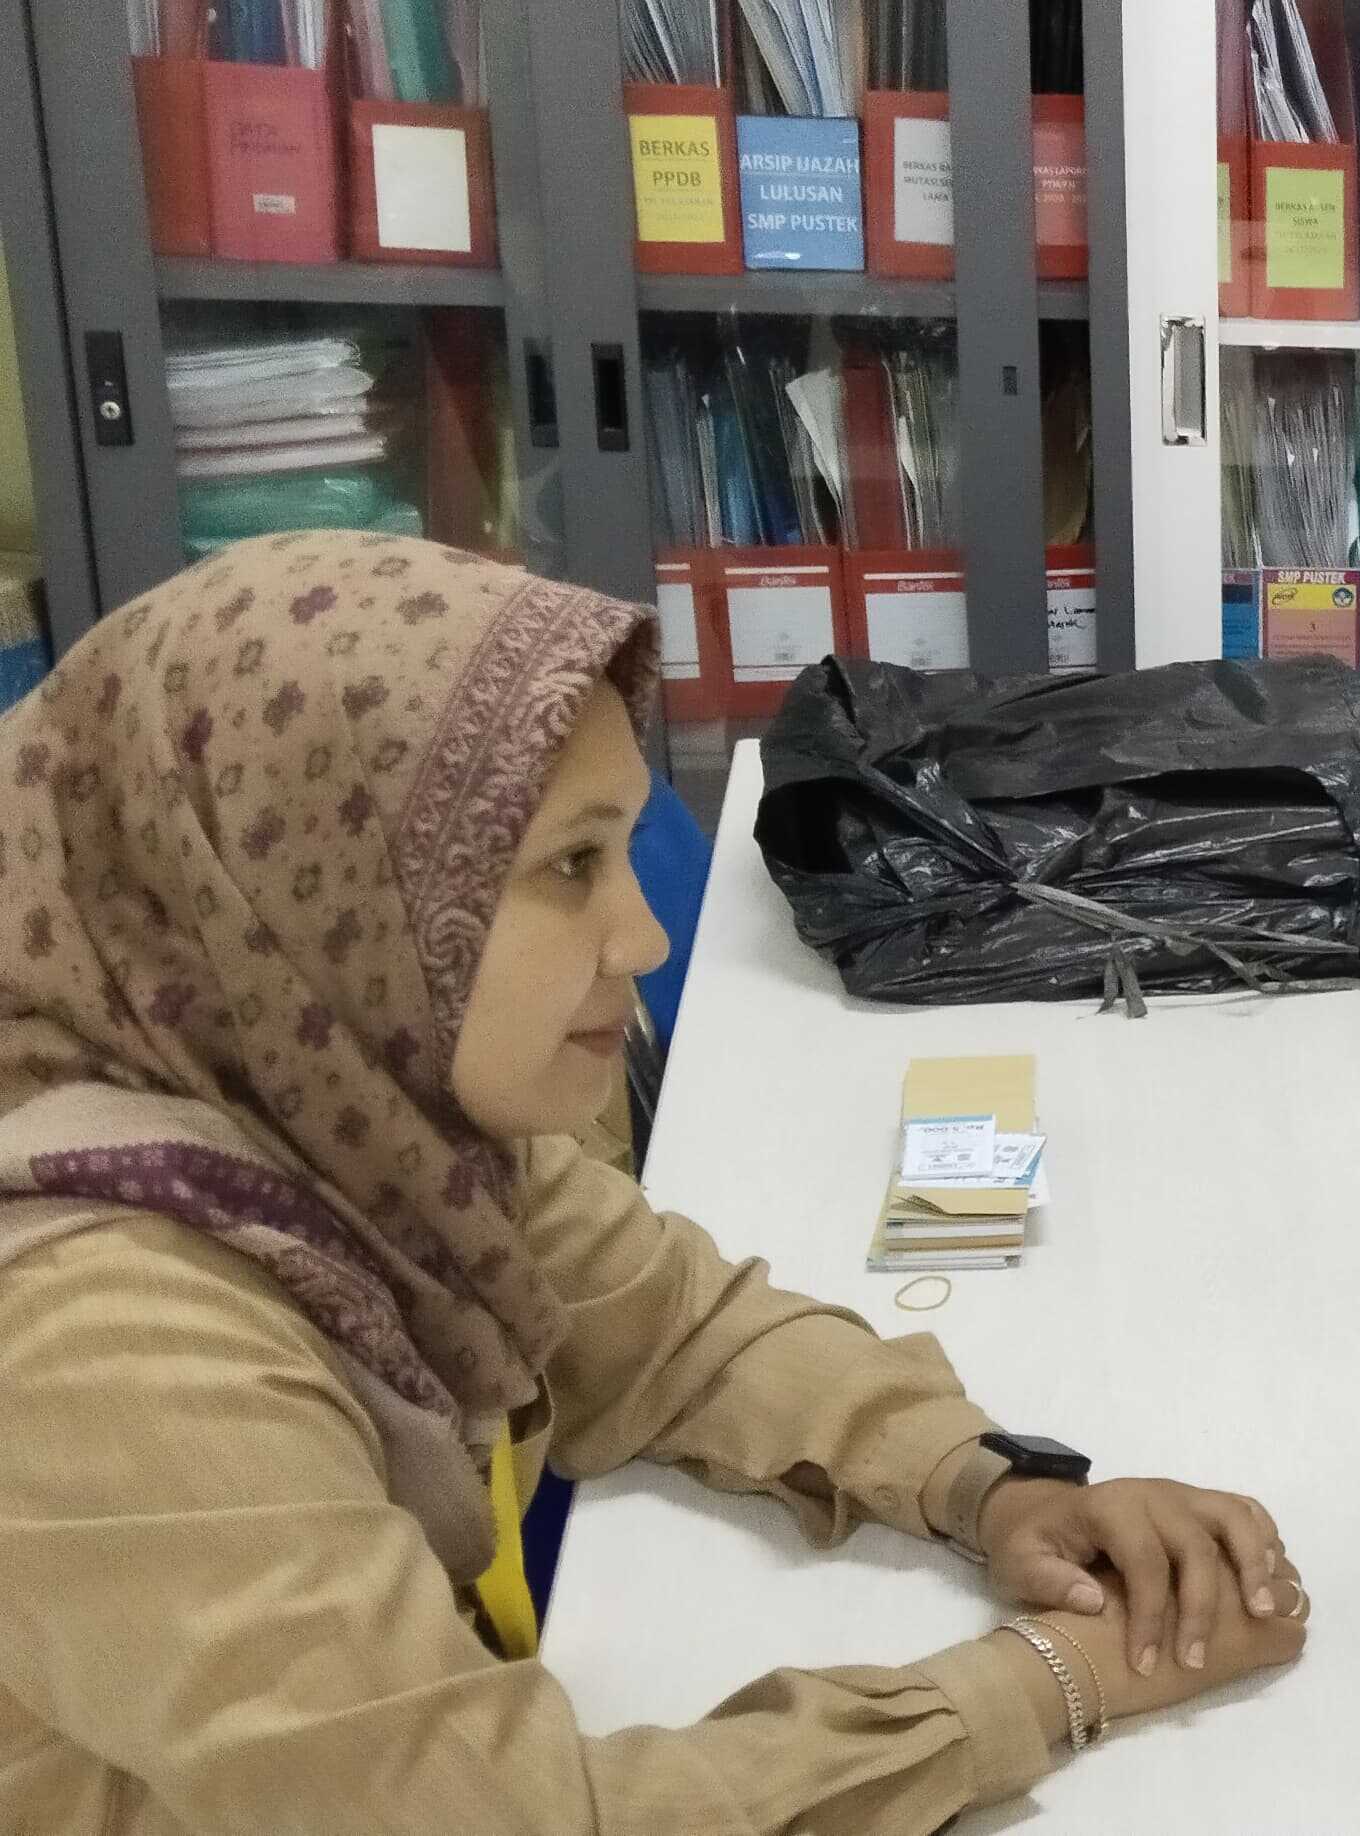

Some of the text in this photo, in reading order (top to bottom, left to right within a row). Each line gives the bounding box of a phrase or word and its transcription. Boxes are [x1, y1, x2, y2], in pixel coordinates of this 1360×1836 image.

[639, 140, 711, 157] BERKAS
[740, 154, 859, 174] ARSIP IJAZAH
[653, 171, 702, 187] PPDB
[760, 184, 843, 203] LULUSAN
[747, 213, 858, 232] SMP PUSTEK
[1277, 571, 1347, 584] SMP PUSTEK
